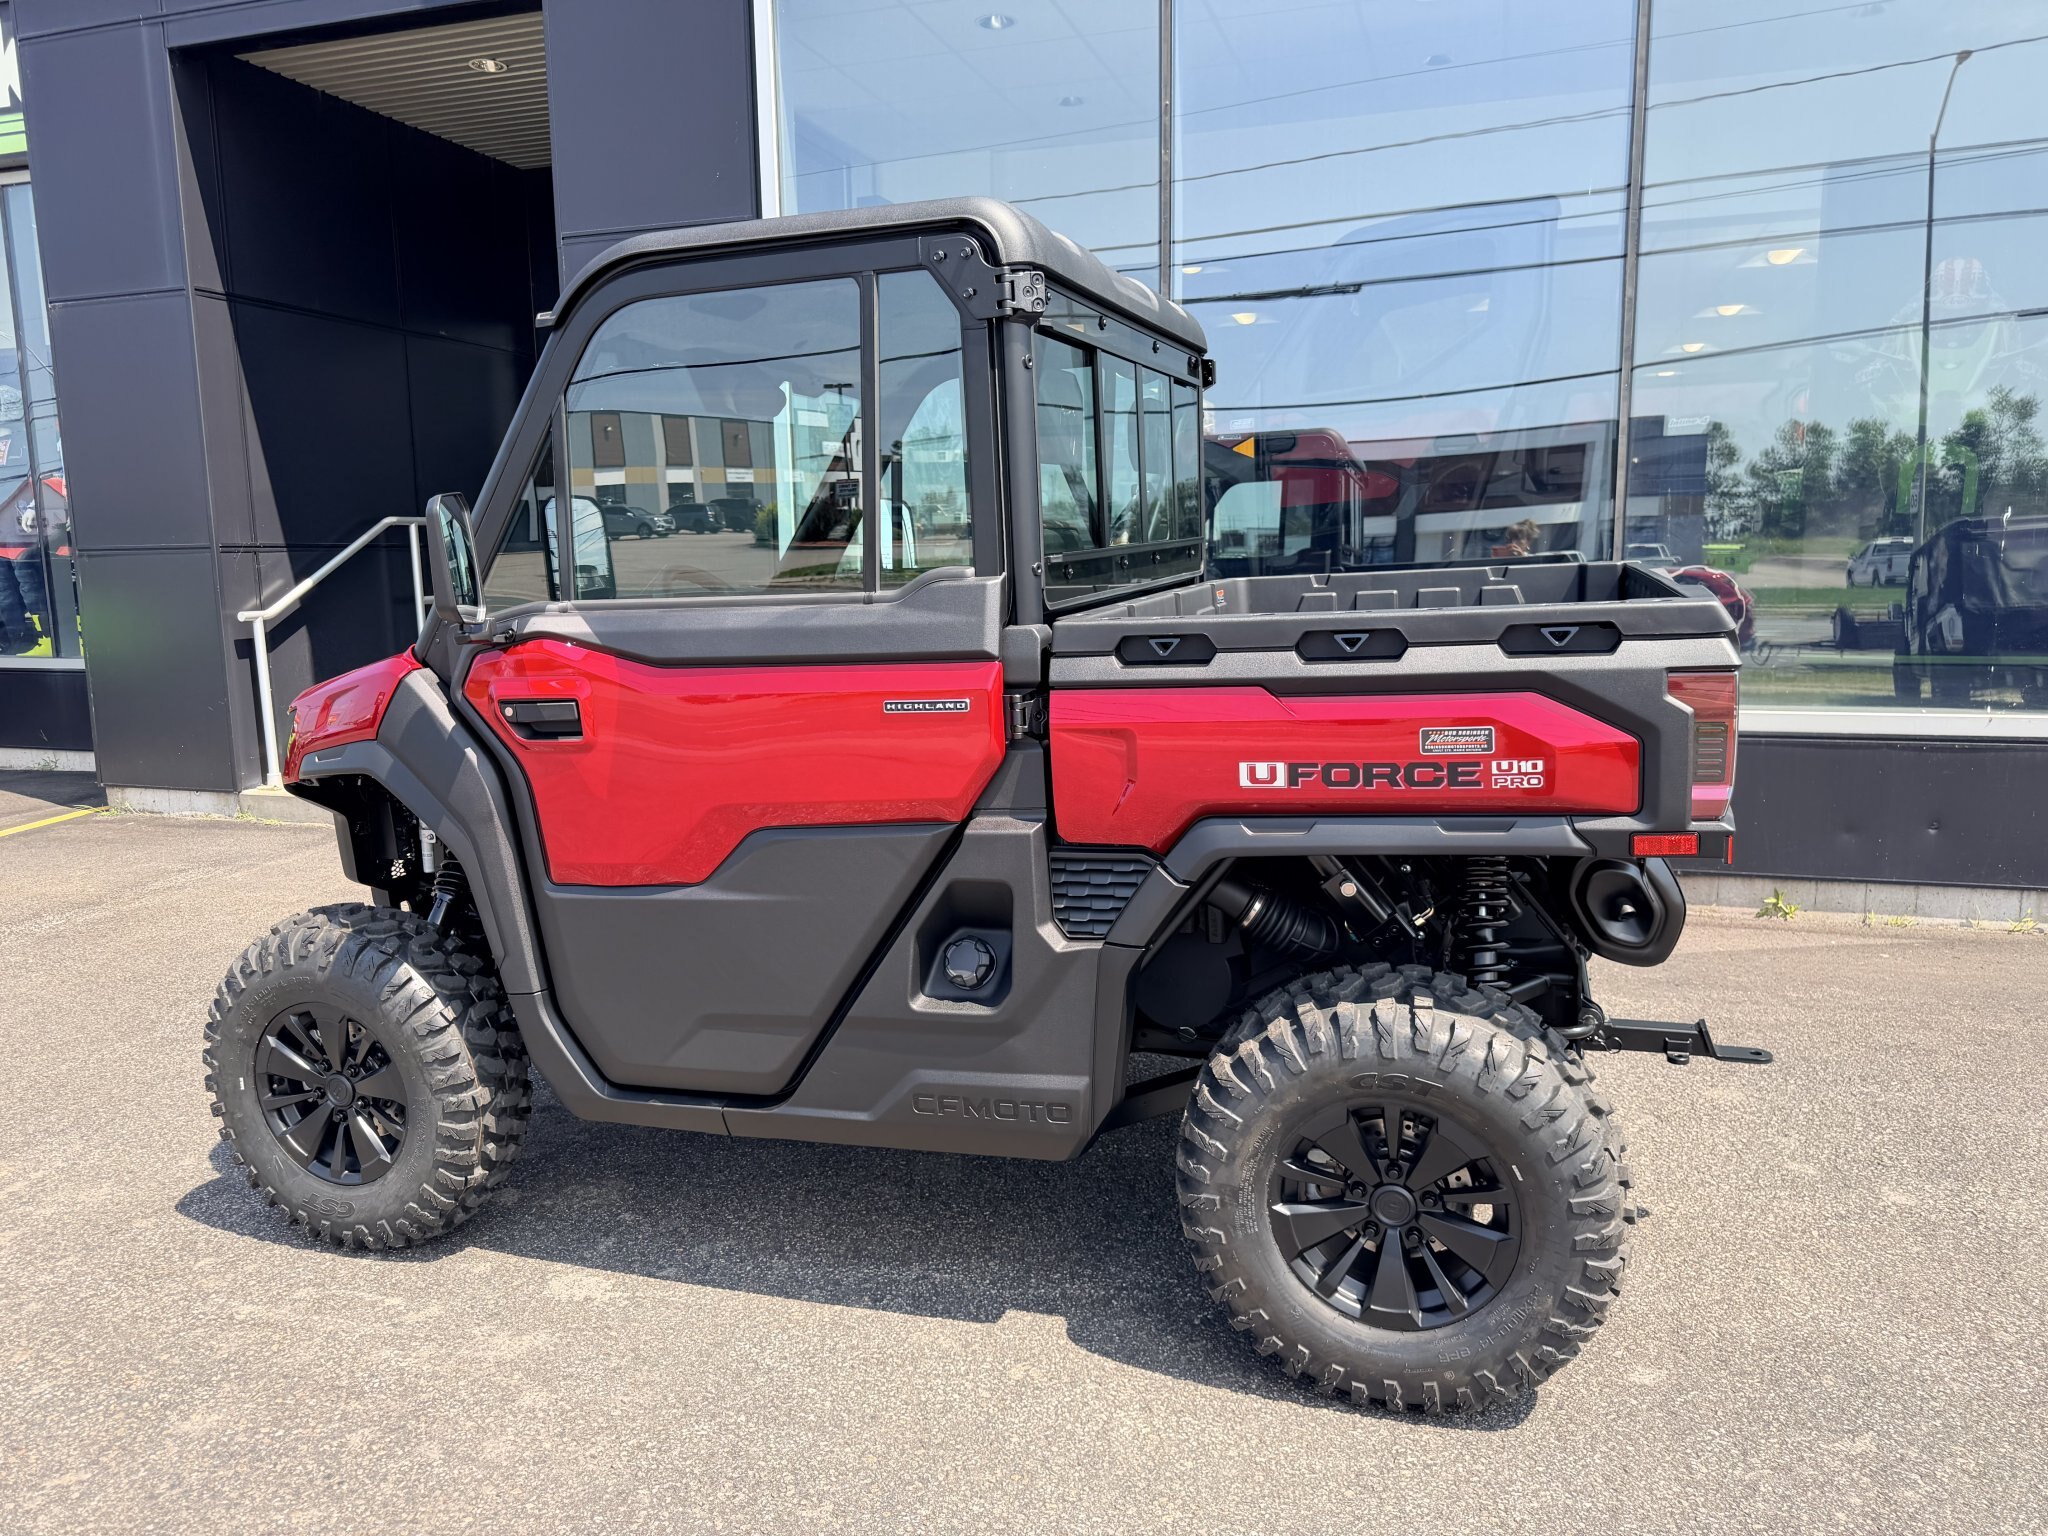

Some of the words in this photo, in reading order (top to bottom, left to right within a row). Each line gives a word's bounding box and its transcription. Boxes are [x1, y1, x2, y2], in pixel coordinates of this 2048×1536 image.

[1425, 734, 1489, 745] Motorsports
[1491, 760, 1544, 774] U10
[1491, 776, 1544, 789] PRO
[1350, 1071, 1444, 1098] CST
[912, 1093, 1074, 1124] CFMOTO
[302, 1192, 356, 1218] CST
